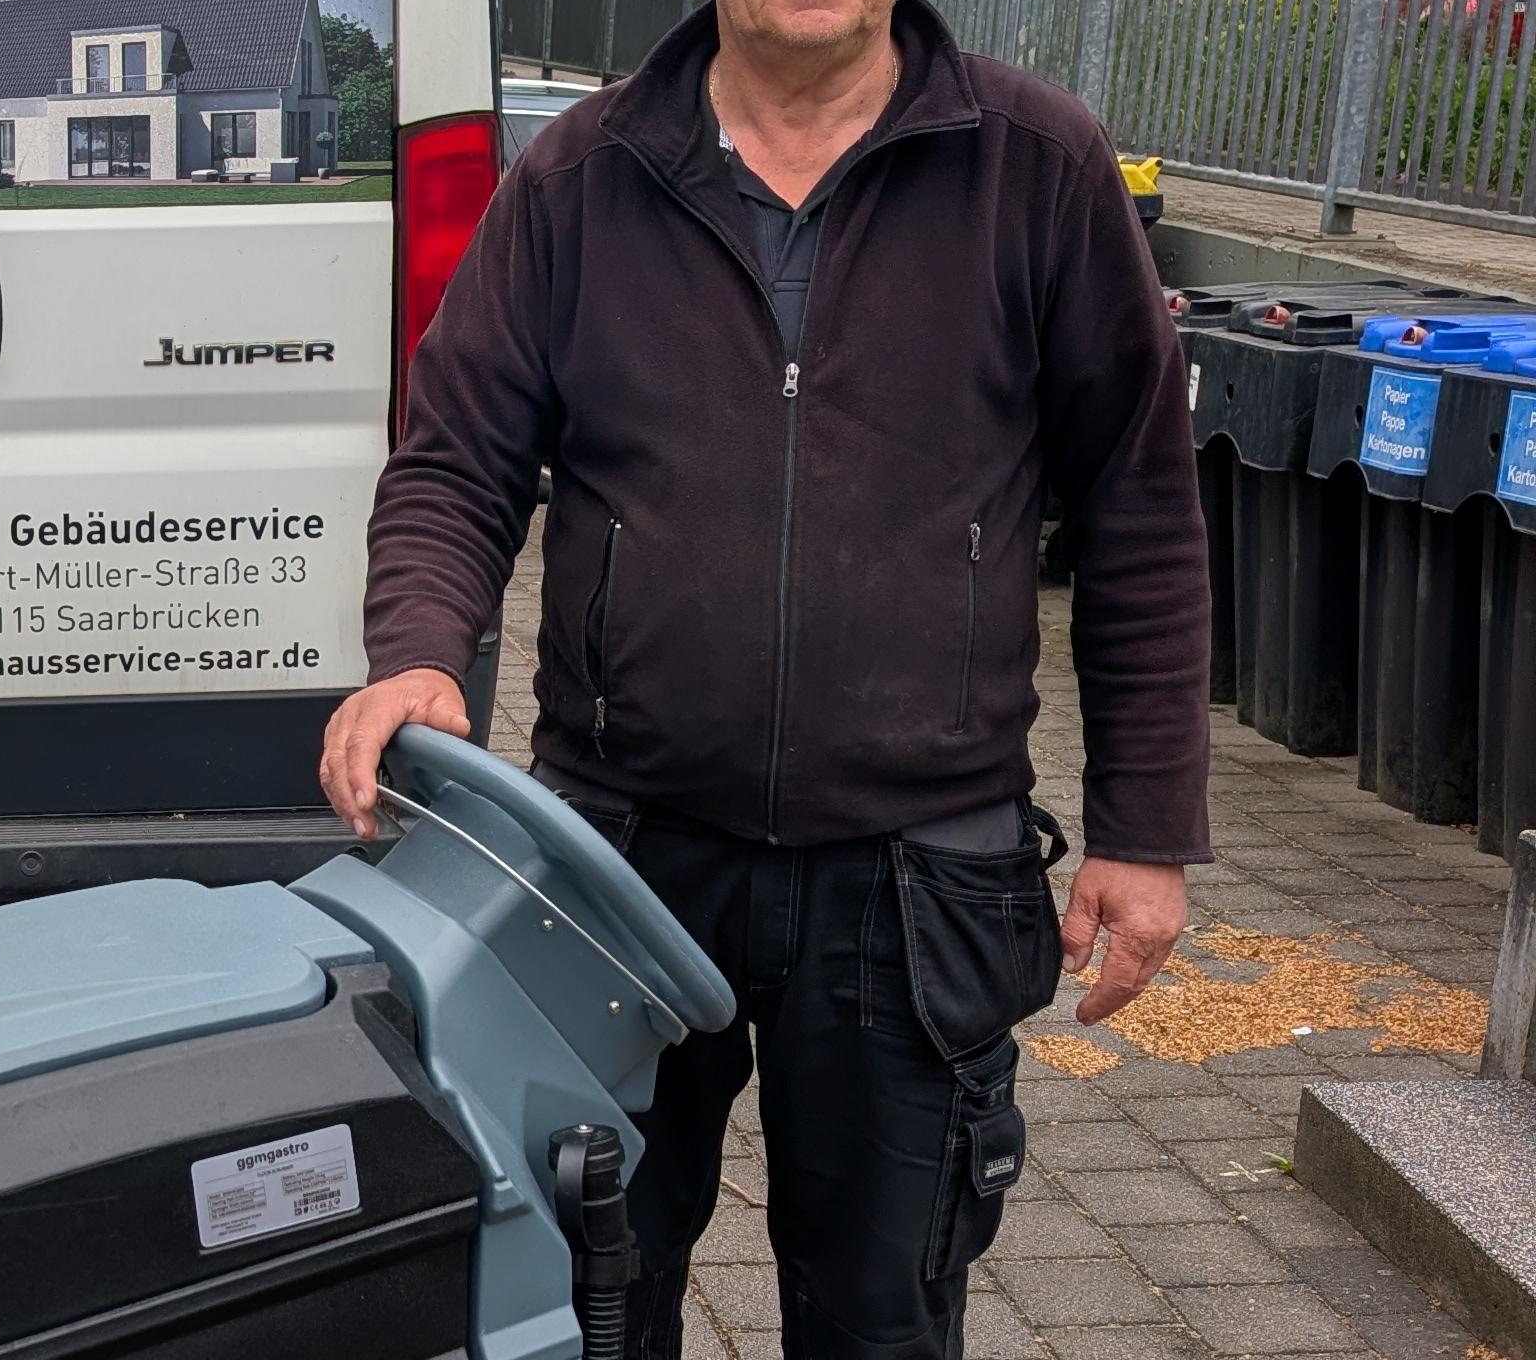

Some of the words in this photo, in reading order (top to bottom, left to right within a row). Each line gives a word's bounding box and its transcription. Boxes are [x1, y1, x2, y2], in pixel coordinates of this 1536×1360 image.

[1384, 385, 1410, 405] Papier
[1381, 411, 1406, 432] Pappe
[1368, 434, 1426, 460] Kartonagen
[1507, 464, 1536, 487] Karto
[10, 507, 326, 548] Gebäudeservice
[270, 555, 308, 583] 33
[57, 601, 262, 633] Saarbrücken
[236, 1142, 309, 1171] ggmgastro
